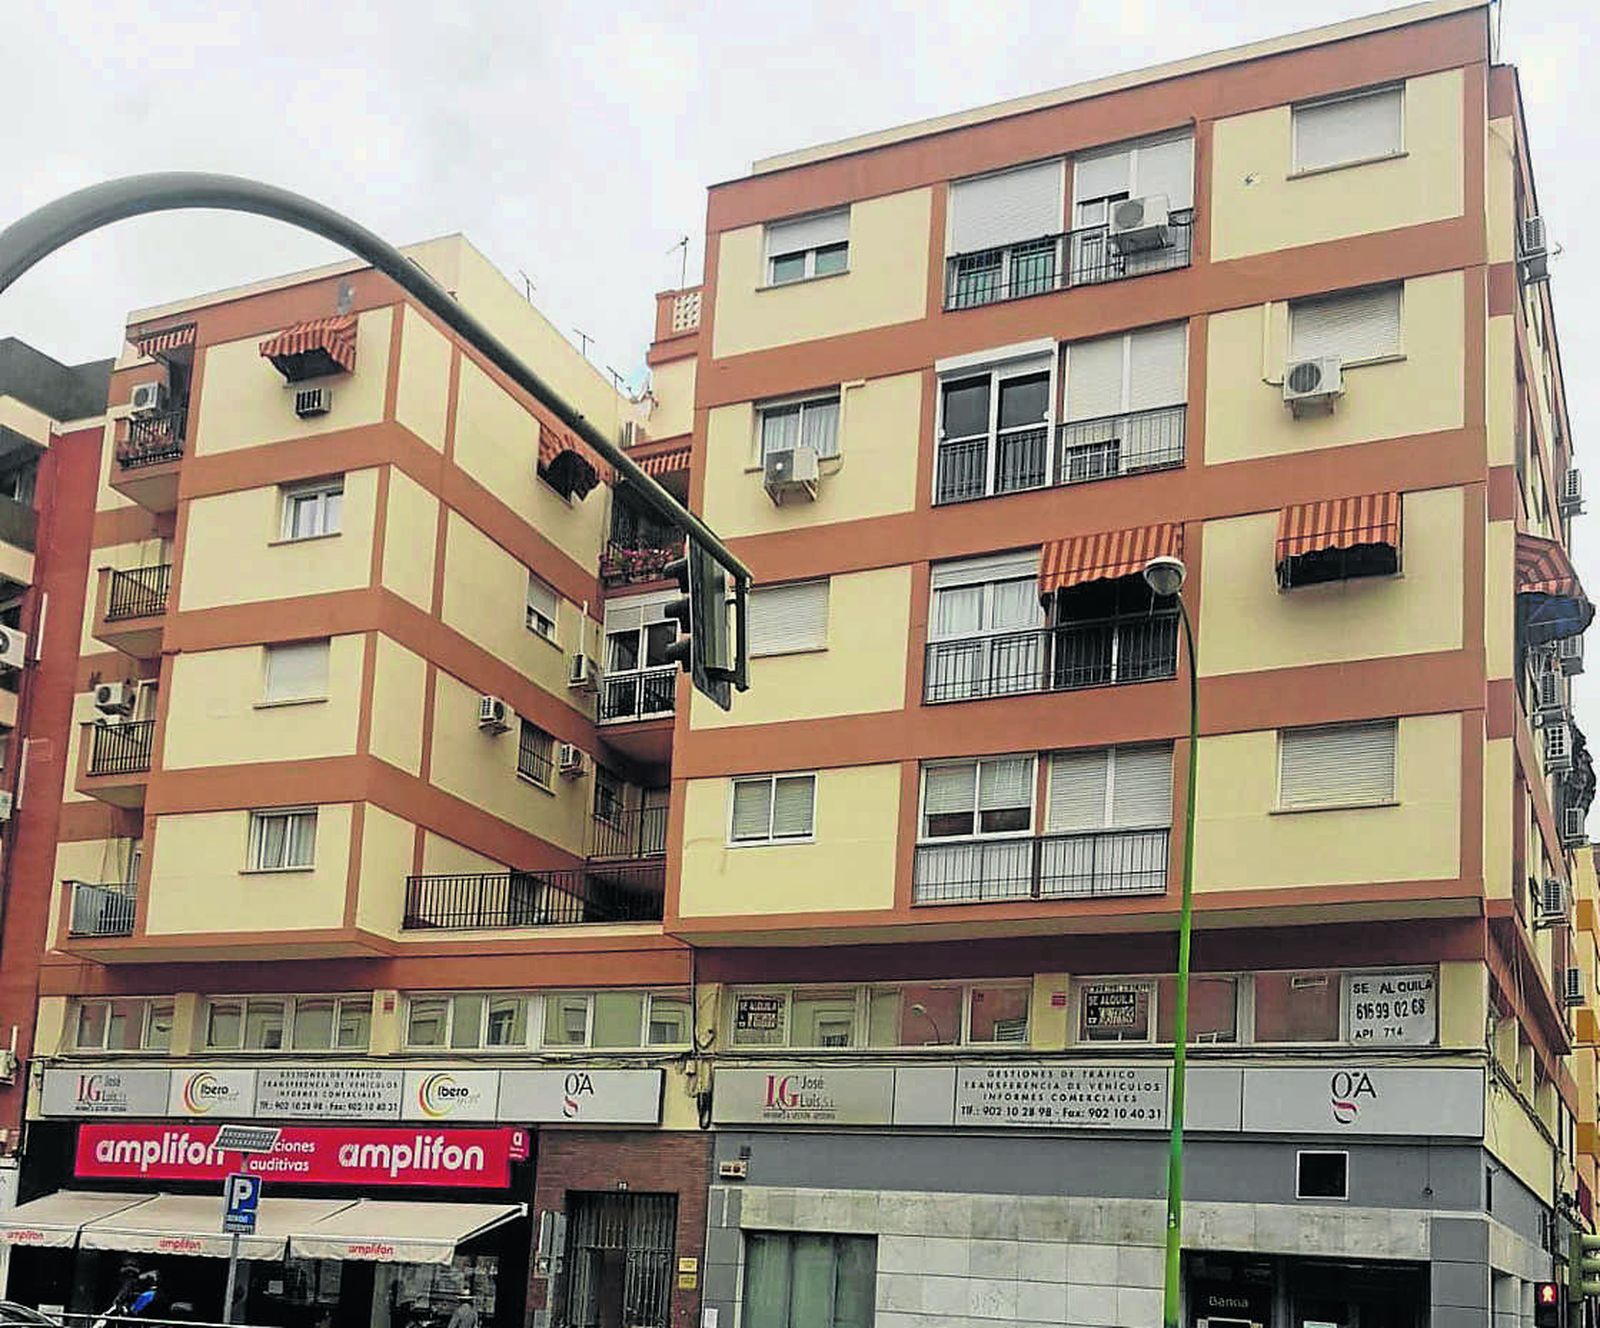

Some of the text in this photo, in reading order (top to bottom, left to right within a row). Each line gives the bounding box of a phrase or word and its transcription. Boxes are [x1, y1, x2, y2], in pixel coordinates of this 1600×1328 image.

[1353, 983, 1370, 994] SE
[987, 1069, 1053, 1079] GESTIONES
[1060, 1069, 1074, 1078] DE
[964, 1080, 1060, 1090] TRANSFERENCIA
[1067, 1082, 1080, 1091] DE
[983, 1092, 1137, 1103] INFORMES COMERCIALES
[983, 1105, 1002, 1116] 902
[1006, 1106, 1019, 1116] 10
[1022, 1106, 1035, 1117] 28
[1038, 1106, 1052, 1117] 98
[1088, 1107, 1109, 1119] 902
[1114, 1108, 1127, 1119] 10
[1130, 1108, 1145, 1120] 40
[1148, 1108, 1162, 1120] 31
[96, 1132, 225, 1172] amplifon
[338, 1134, 485, 1178] amplifon
[249, 1156, 310, 1172] auditivas
[231, 1178, 253, 1210] P
